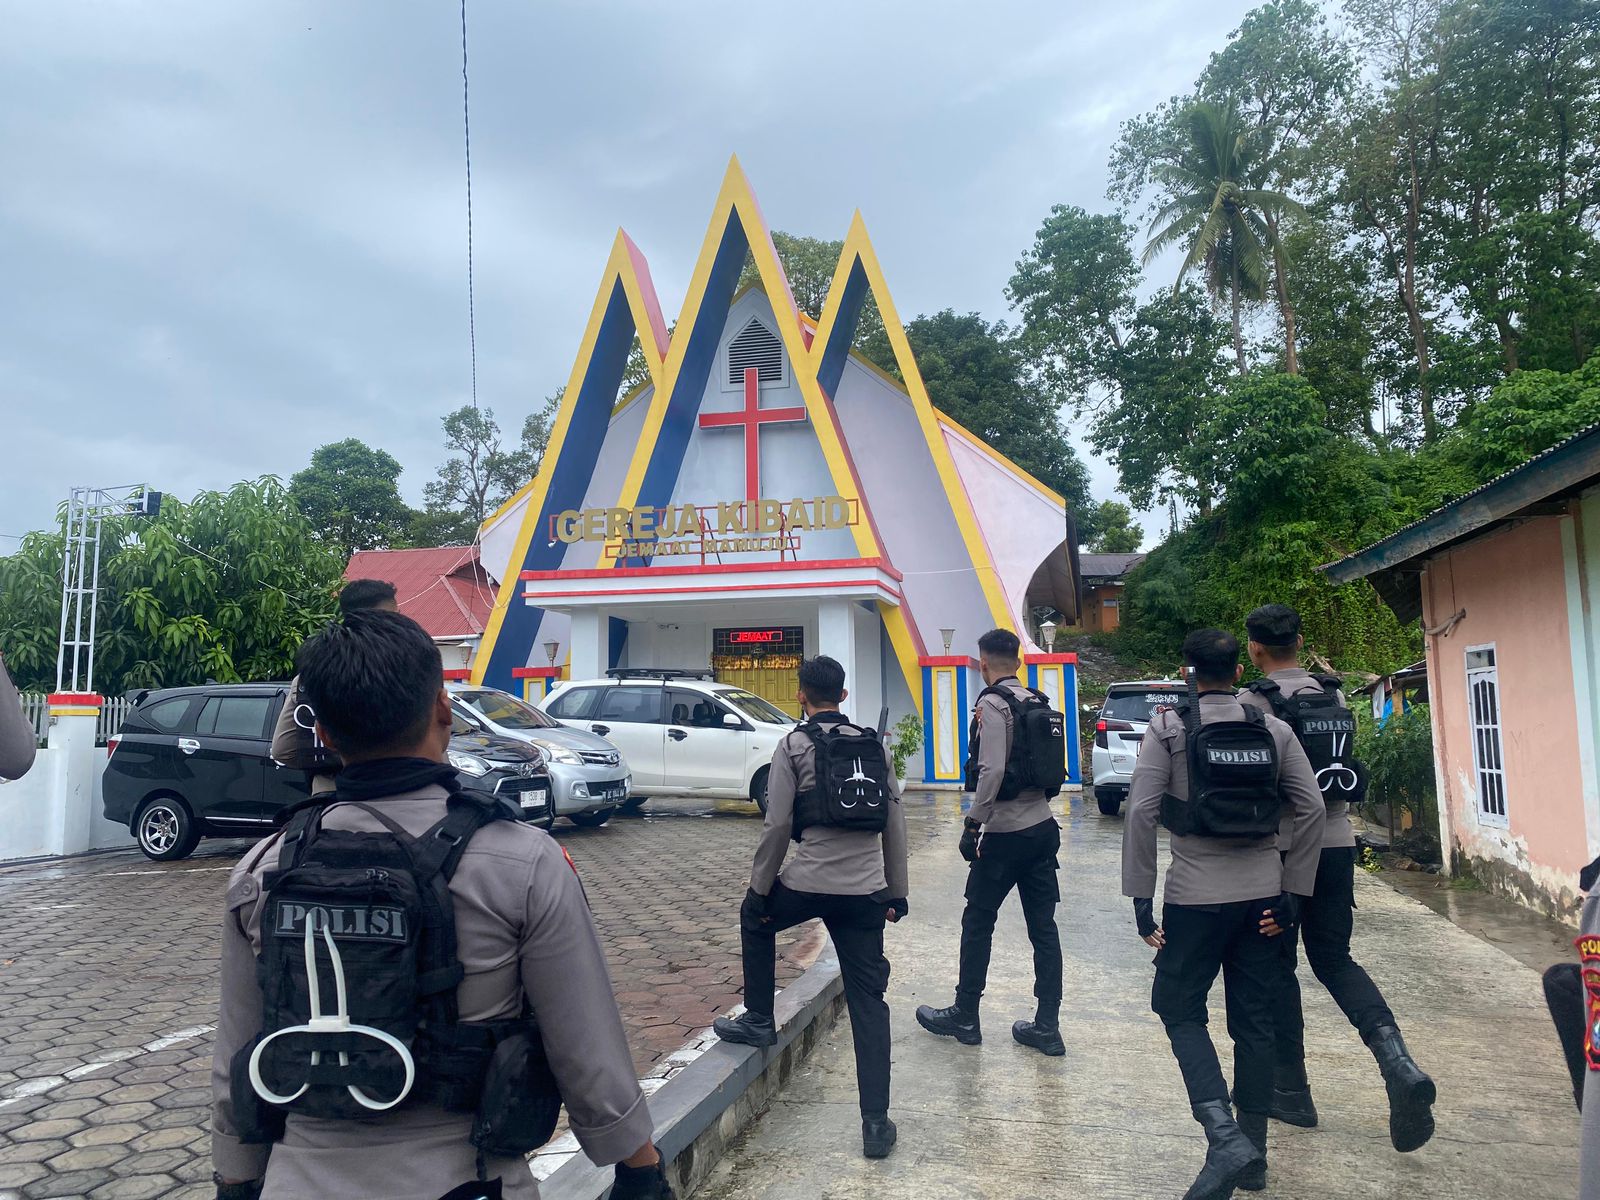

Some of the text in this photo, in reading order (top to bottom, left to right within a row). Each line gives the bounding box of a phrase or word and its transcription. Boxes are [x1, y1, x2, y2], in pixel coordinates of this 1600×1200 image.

[556, 495, 850, 544] GEREJA KIBAID
[616, 536, 789, 558] JEMAAT MAMUJU
[737, 631, 774, 641] JEMAAT
[1305, 720, 1354, 732] POLISI
[1210, 750, 1269, 763] POLISI
[280, 904, 404, 937] POLISI
